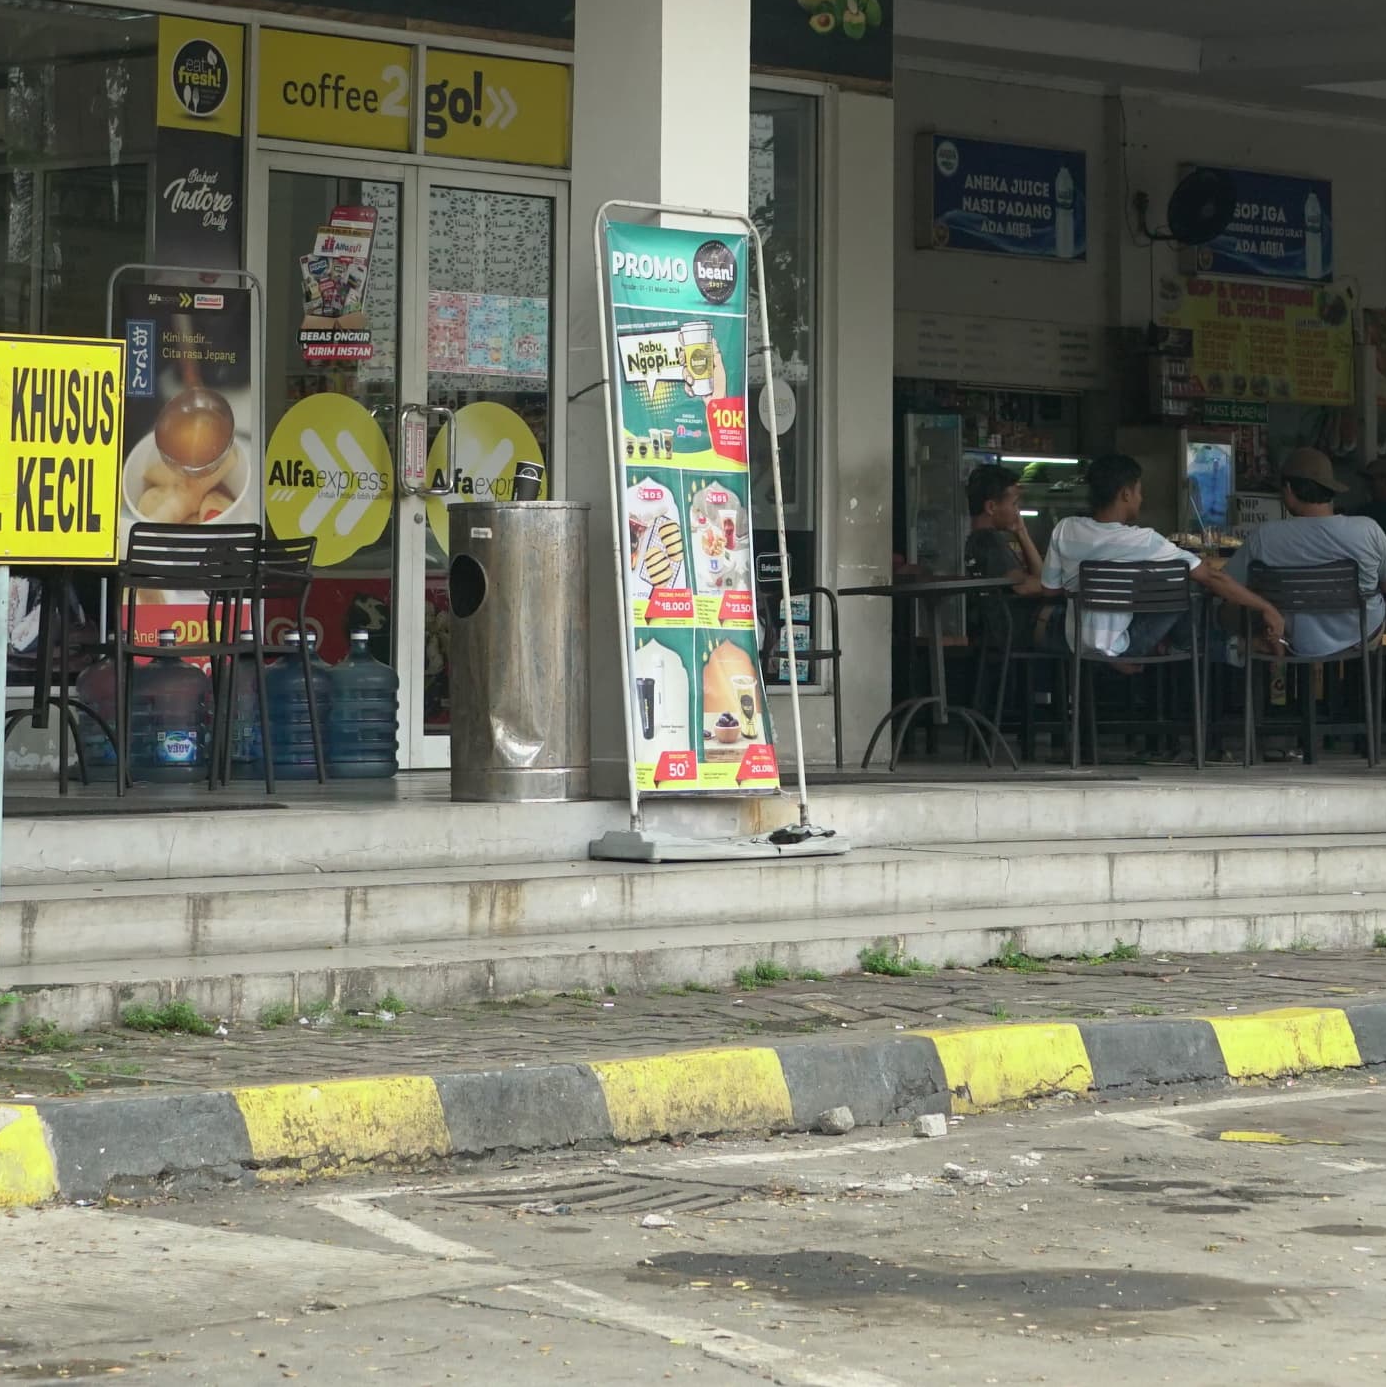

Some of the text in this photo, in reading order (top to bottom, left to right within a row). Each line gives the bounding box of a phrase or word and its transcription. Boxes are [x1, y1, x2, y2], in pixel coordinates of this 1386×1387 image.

[185, 55, 207, 73] eat
[177, 66, 222, 88] fresh!
[187, 168, 219, 184] Baked
[964, 173, 1050, 198] ANEKA JUICE
[163, 177, 234, 213] Instore
[962, 196, 1053, 220] NASI PADANG
[1233, 201, 1287, 223] SOP IGA
[202, 211, 228, 232] Daily
[980, 219, 1005, 234] ADA
[612, 250, 688, 283] PROMO
[697, 261, 734, 281] bean!
[162, 332, 181, 343] Kini
[299, 331, 370, 343] BEBAS ONGKIR
[638, 340, 662, 354] Rabu
[131, 325, 148, 390] おでん
[162, 347, 236, 365] Cita rasa Jepang
[307, 345, 335, 357] KIRIM
[337, 345, 372, 357] INSTAN
[10, 366, 115, 446] KHUSUS
[15, 456, 102, 534] KECIL
